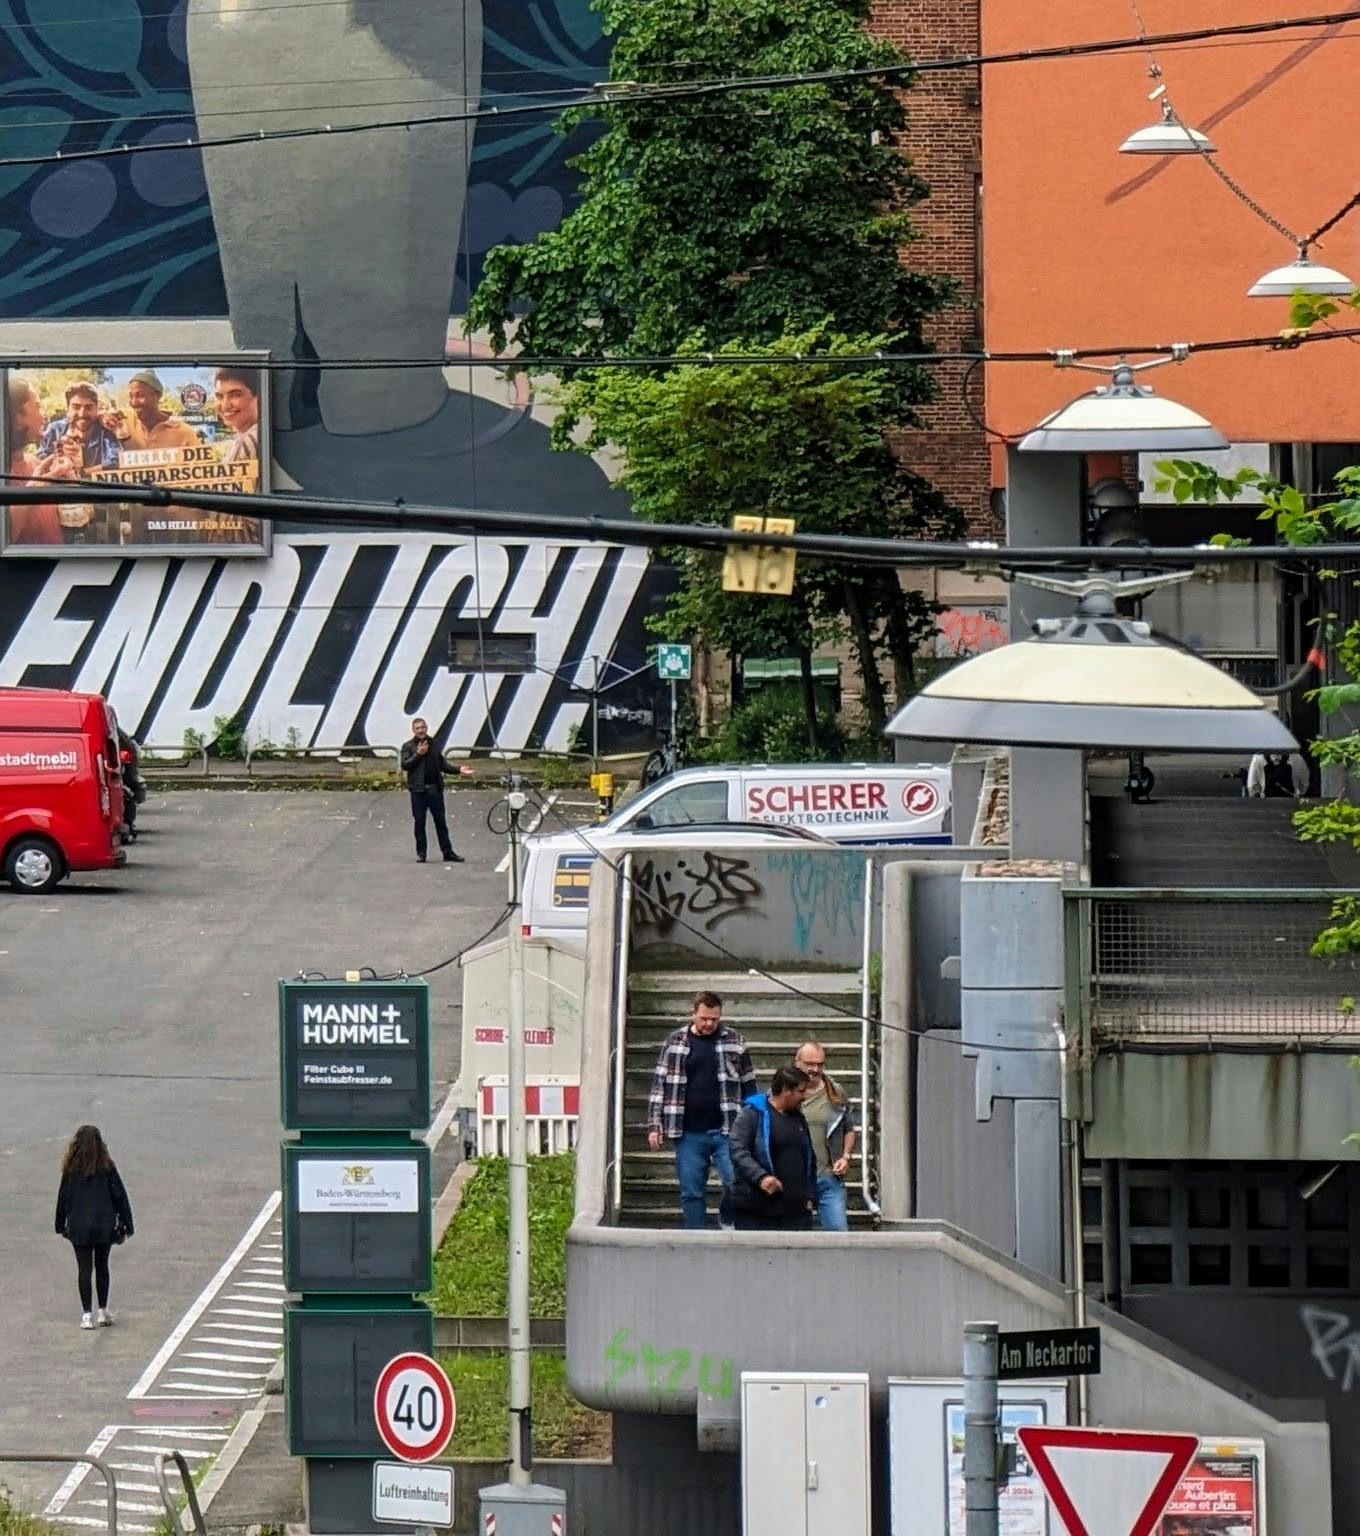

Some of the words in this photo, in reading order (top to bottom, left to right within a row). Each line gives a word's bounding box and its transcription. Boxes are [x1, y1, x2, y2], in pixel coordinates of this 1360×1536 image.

[183, 447, 214, 462] DIE
[147, 520, 166, 530] DAS
[167, 519, 197, 530] HELLE
[748, 782, 888, 814] SCHERER
[303, 1024, 410, 1044] HUMMEL
[303, 1065, 329, 1074] Filter
[330, 1065, 354, 1074] Cube
[1000, 1342, 1022, 1369] Am
[1026, 1339, 1095, 1368] Neckartor
[393, 1384, 438, 1433] 40
[379, 1482, 450, 1507] Luftreinhaltung
[1199, 1501, 1211, 1510] et
[1212, 1501, 1237, 1512] plus
